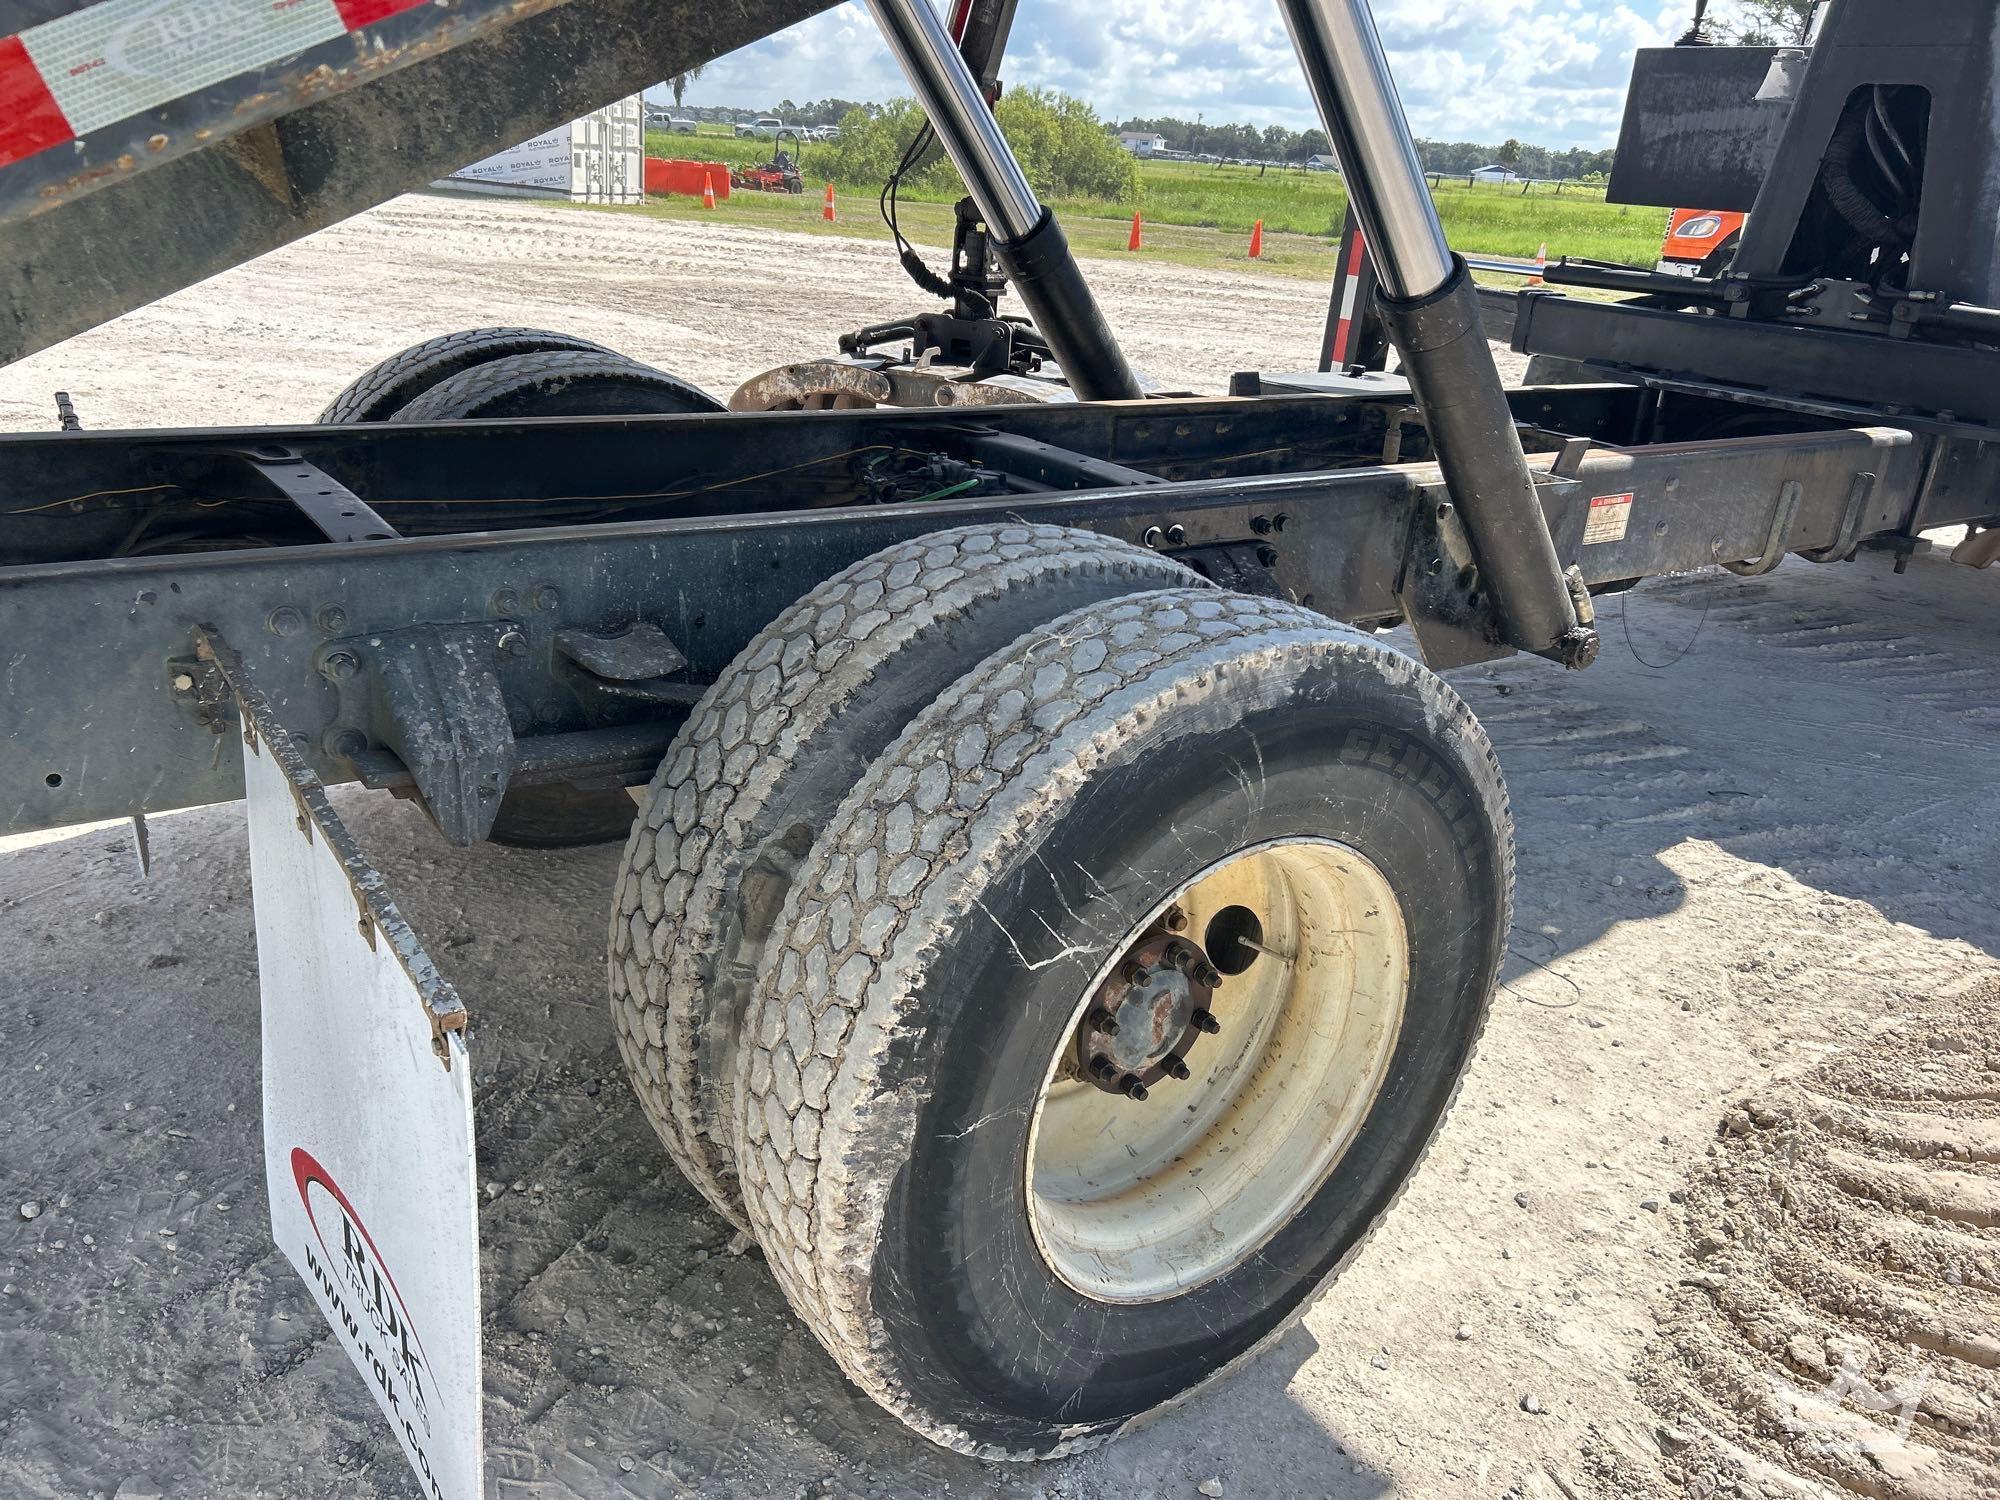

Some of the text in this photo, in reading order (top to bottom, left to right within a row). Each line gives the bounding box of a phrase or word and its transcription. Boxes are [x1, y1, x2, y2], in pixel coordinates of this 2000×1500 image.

[511, 161, 534, 169] ROYAL
[472, 166, 496, 174] ROYAL
[534, 176, 558, 184] ROYAL
[339, 1206, 429, 1414] RDK
[344, 1258, 431, 1439] TRUCK SALES
